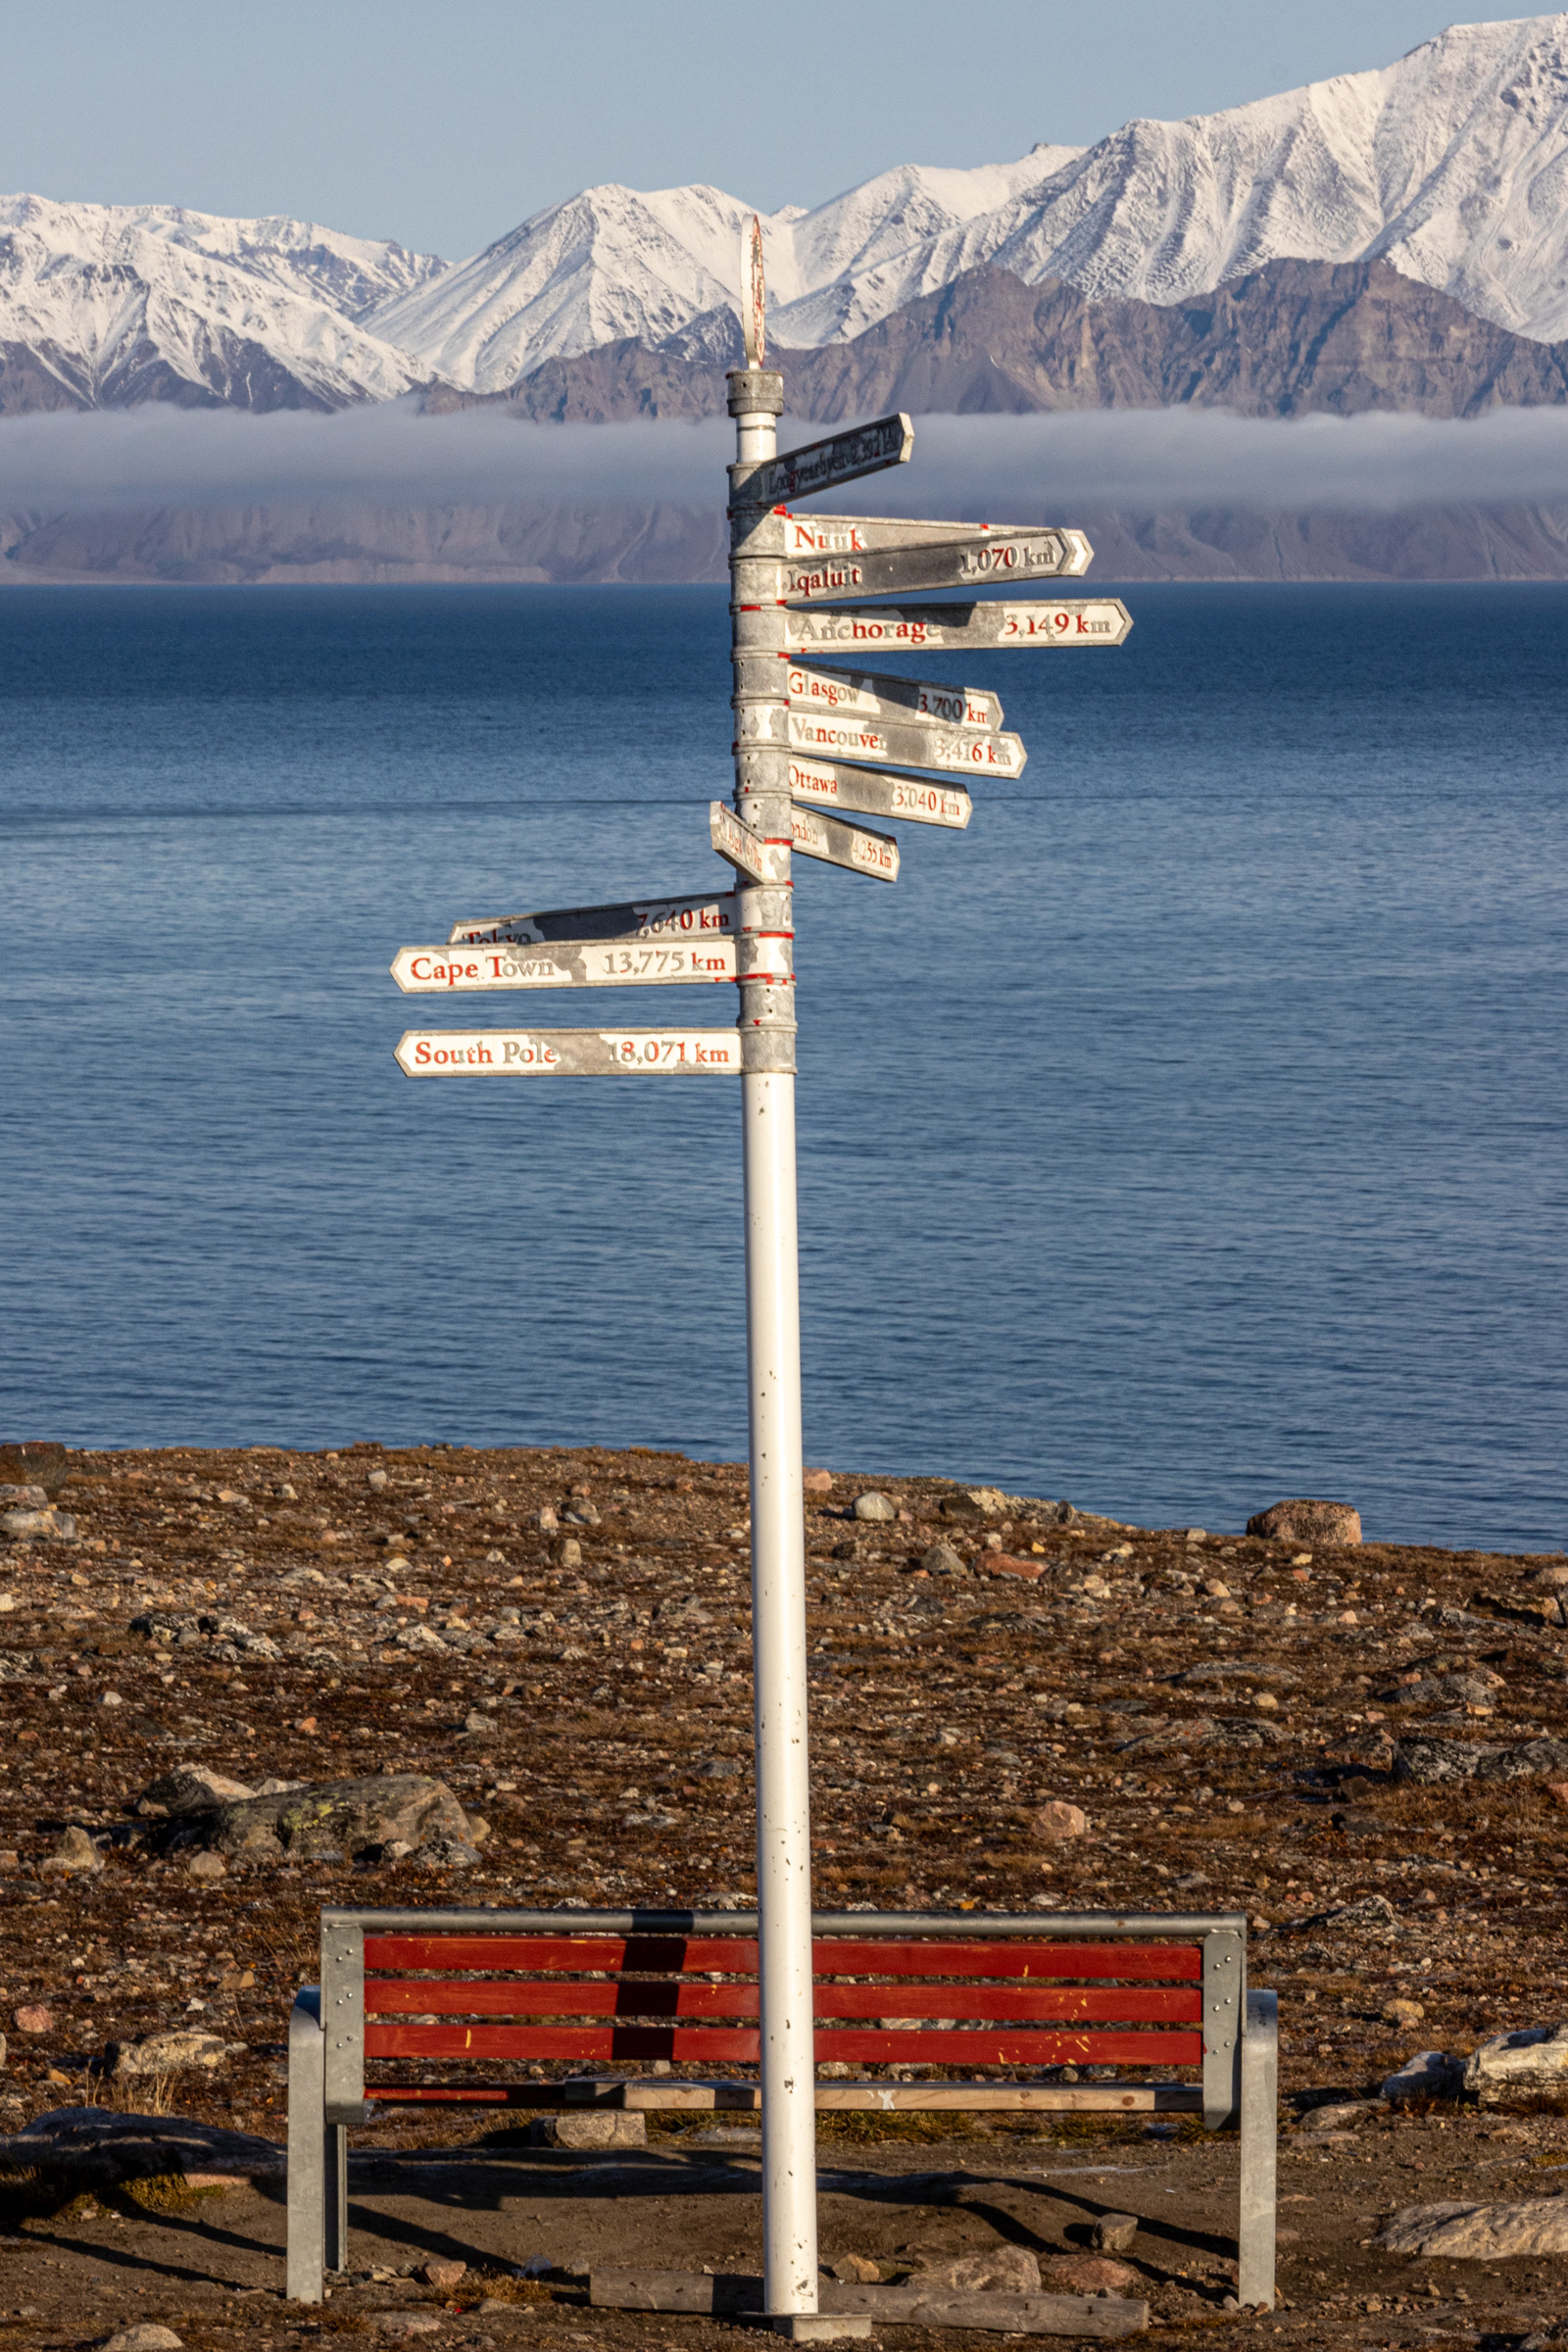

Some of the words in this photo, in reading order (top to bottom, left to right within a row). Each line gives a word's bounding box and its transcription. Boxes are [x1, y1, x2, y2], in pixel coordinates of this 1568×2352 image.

[794, 525, 864, 551] Nuuk
[788, 565, 860, 597] Iqaluit
[960, 546, 1017, 574] 1,070
[1023, 547, 1055, 566] km
[797, 617, 941, 644] Anchorage
[1004, 613, 1069, 638] 3,149
[1076, 614, 1110, 634] km
[788, 671, 859, 706] Glasgow
[918, 693, 963, 720] 3,700
[966, 703, 988, 723] km
[792, 717, 886, 751] Vancouver
[935, 738, 982, 762] 3,416
[987, 745, 1011, 765] km
[788, 764, 837, 795] Ottawa
[896, 786, 937, 811] 3,040
[941, 795, 959, 815] km
[879, 847, 892, 868] km
[463, 928, 531, 946] Tokyo
[638, 908, 694, 938] 7,640
[700, 907, 729, 929] km
[410, 957, 479, 986] Cape
[486, 956, 555, 978] Town
[605, 951, 685, 975] 13,775
[691, 953, 726, 971] km
[415, 1041, 493, 1064] South
[503, 1041, 557, 1064] Pole
[609, 1040, 686, 1065] 18,071
[695, 1043, 729, 1062] km
